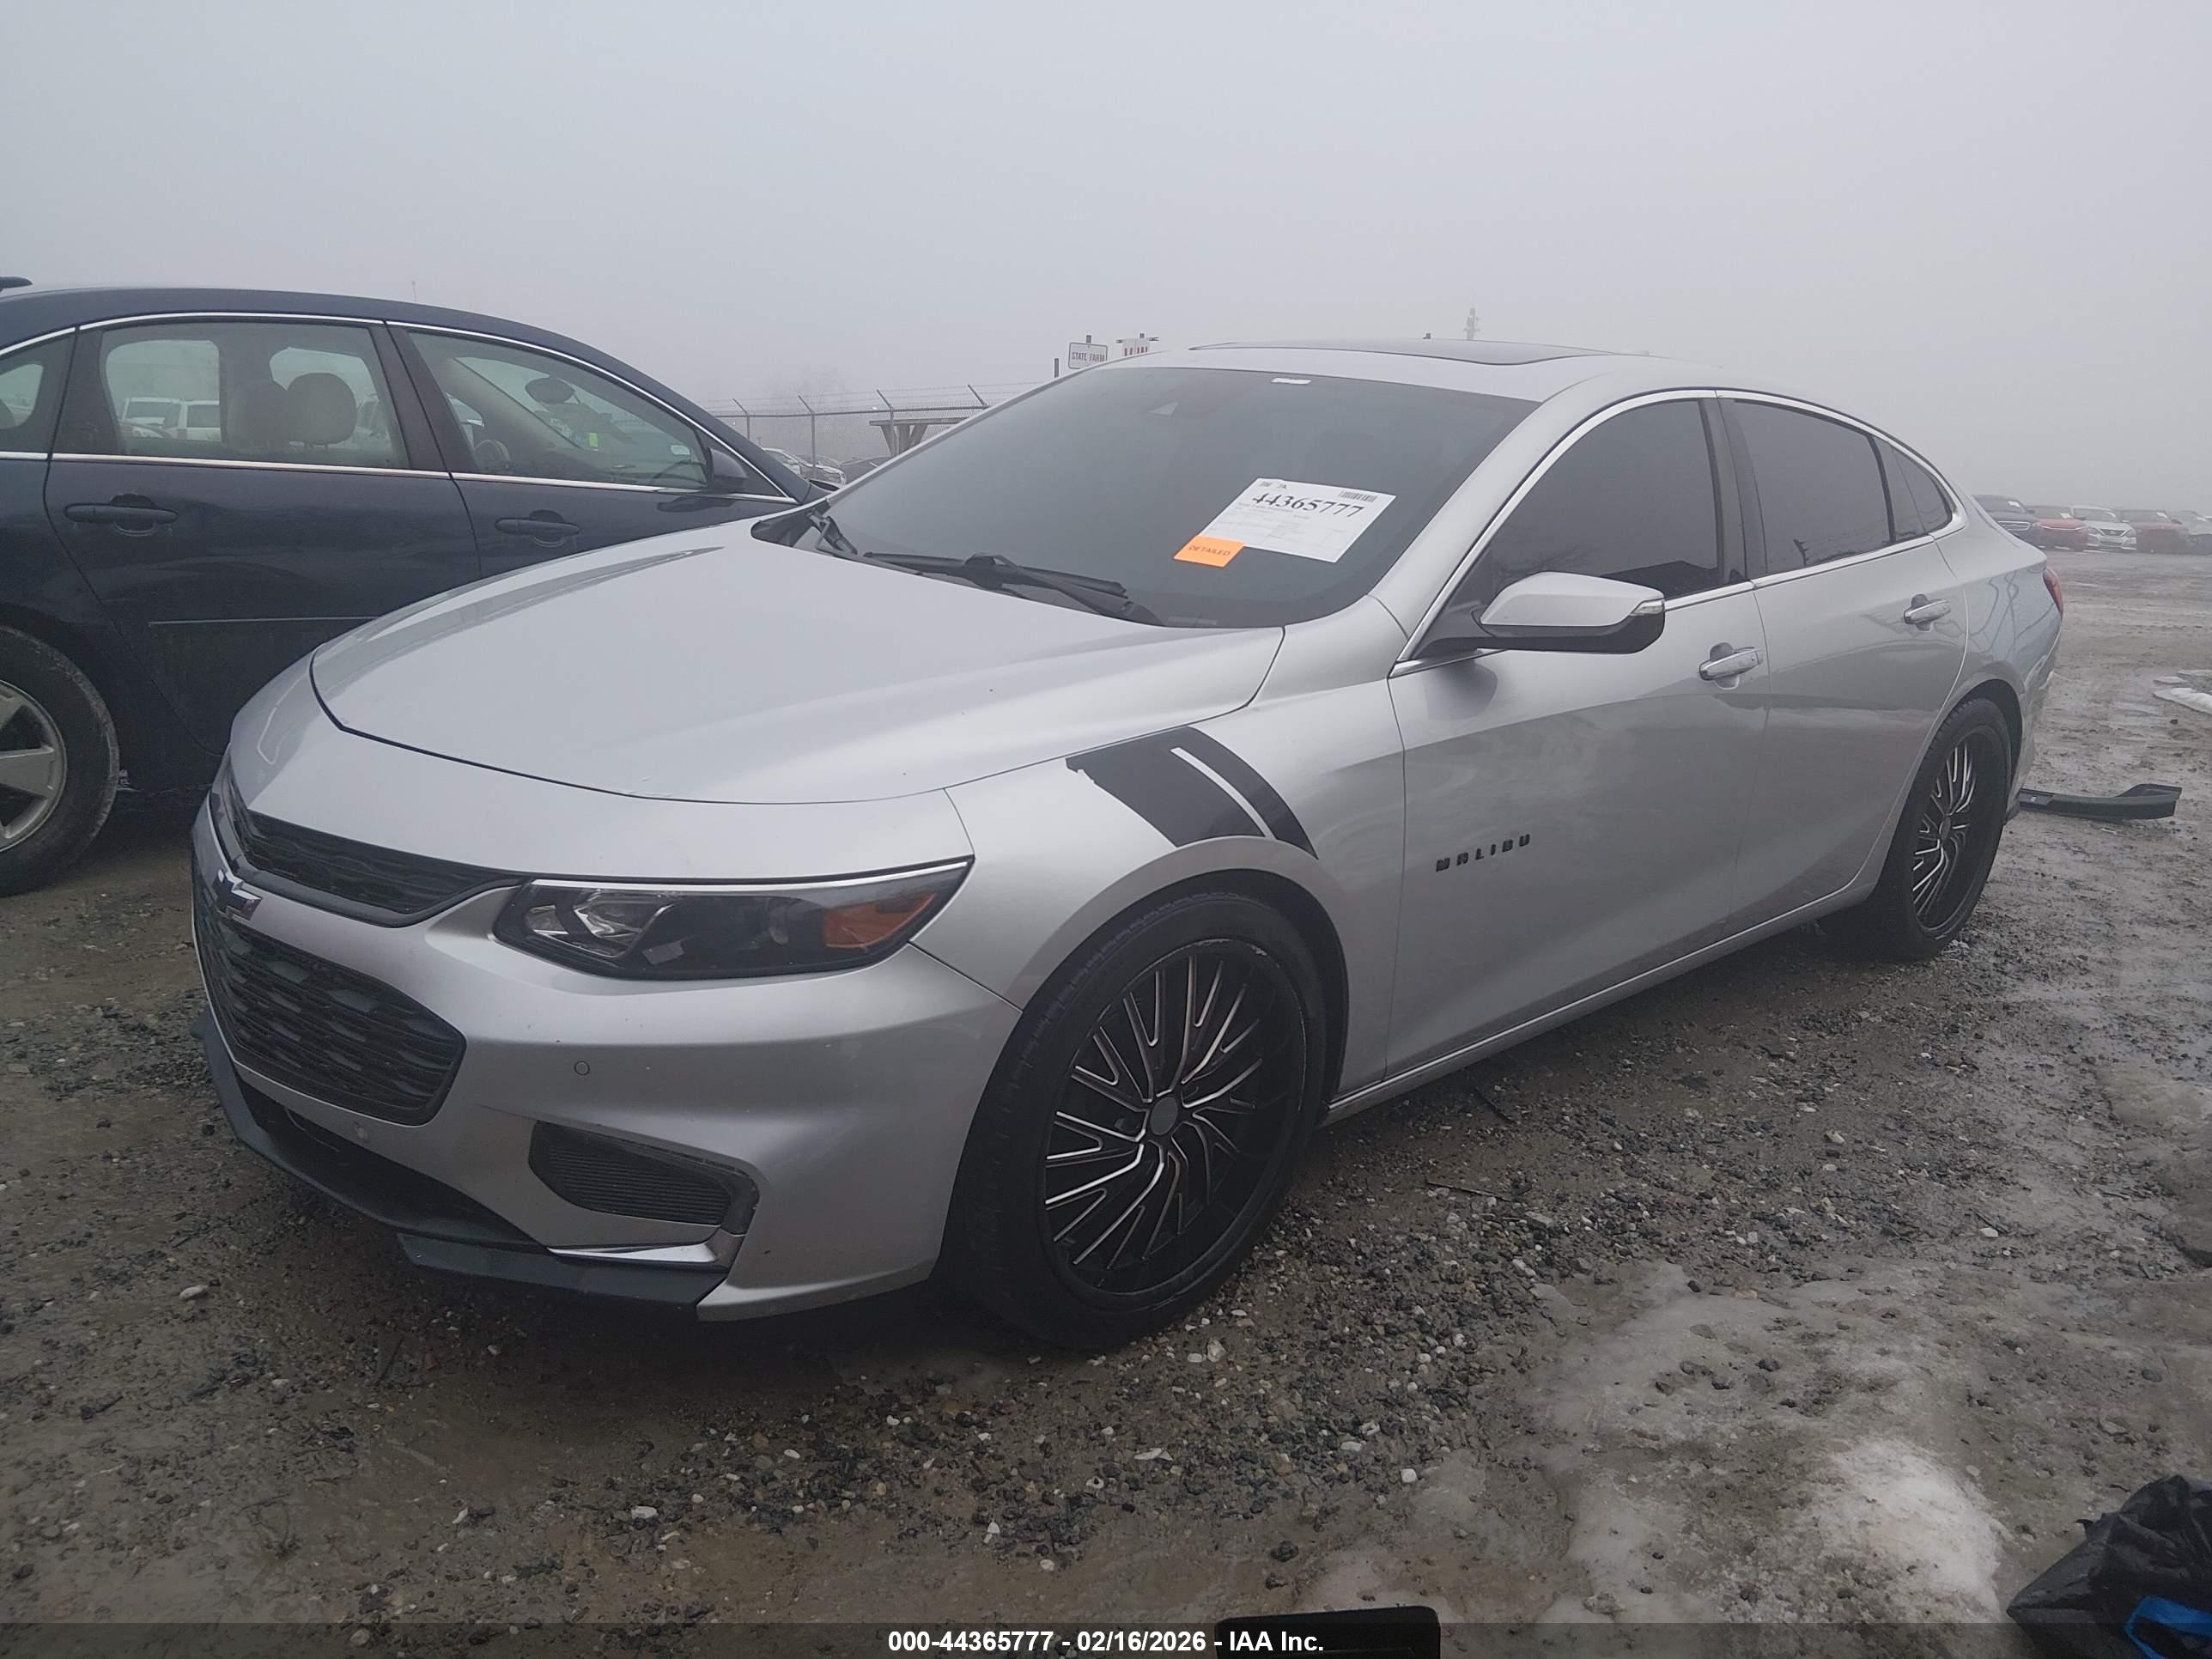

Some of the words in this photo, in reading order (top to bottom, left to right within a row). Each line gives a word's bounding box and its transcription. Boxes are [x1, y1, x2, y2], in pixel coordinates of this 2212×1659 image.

[1072, 351, 1087, 361] STATE
[1089, 353, 1105, 362] FARM
[1253, 492, 1365, 518] 44365777
[1188, 544, 1231, 556] DETAILED
[1435, 833, 1531, 872] MALIBU
